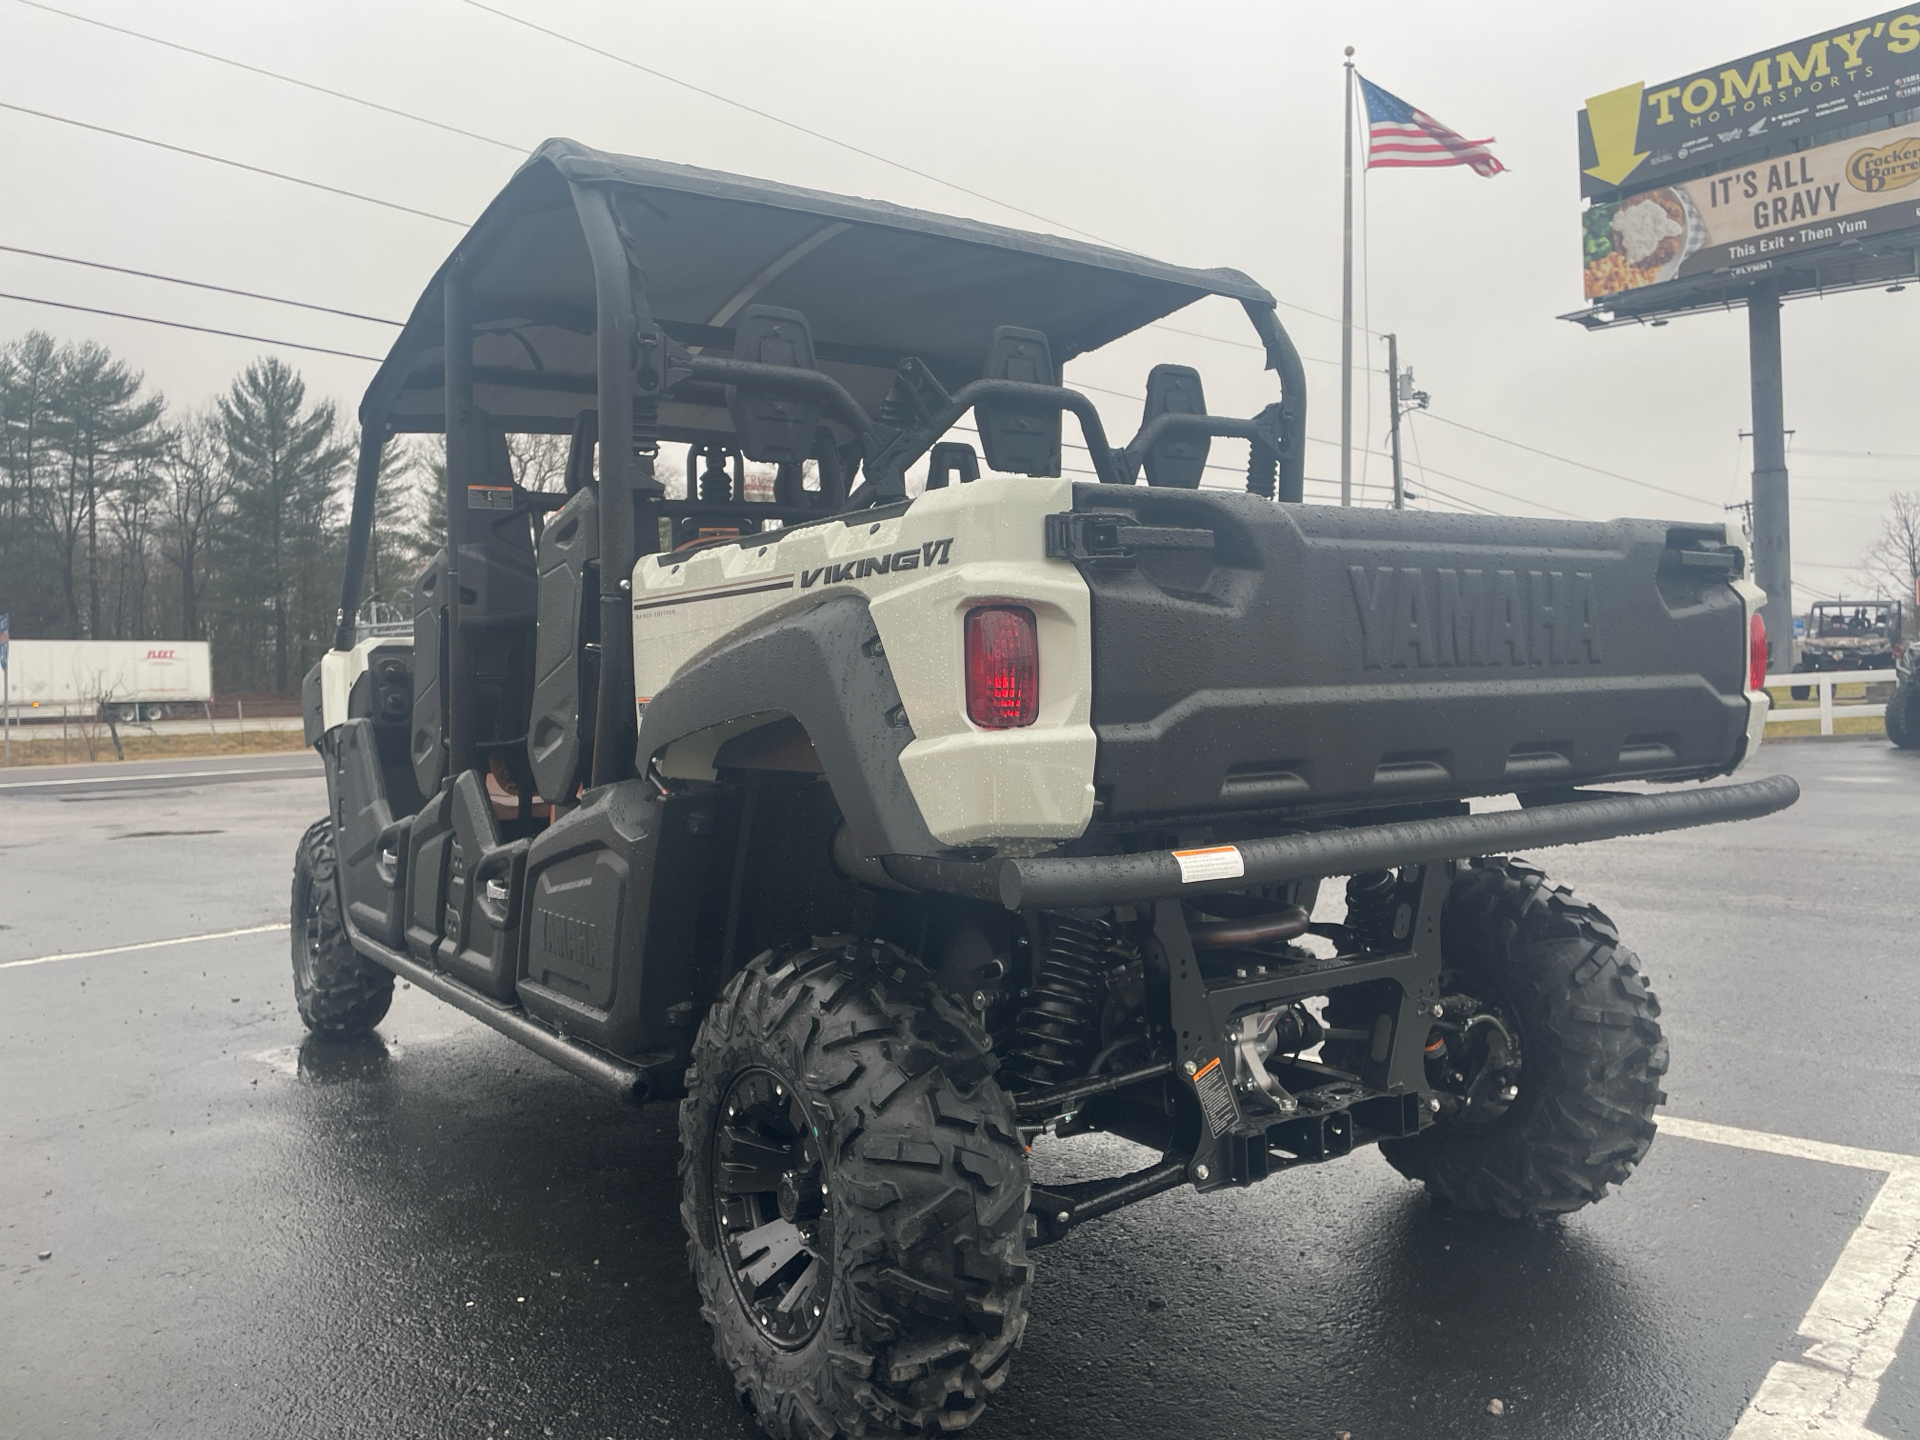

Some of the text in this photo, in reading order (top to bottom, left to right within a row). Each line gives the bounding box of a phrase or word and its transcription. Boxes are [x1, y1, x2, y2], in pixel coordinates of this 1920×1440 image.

[1648, 13, 1920, 126] TOMMY'S
[1689, 65, 1874, 129] MOTORSPORTS
[1710, 156, 1814, 208] IT'S ALL
[1753, 182, 1841, 230] GRAVY
[1728, 218, 1868, 260] This Exit Then Yum
[800, 548, 921, 588] VIKING
[654, 609, 676, 617] EDITION
[1348, 565, 1601, 670] YAMAHA
[147, 650, 174, 659] FLEET
